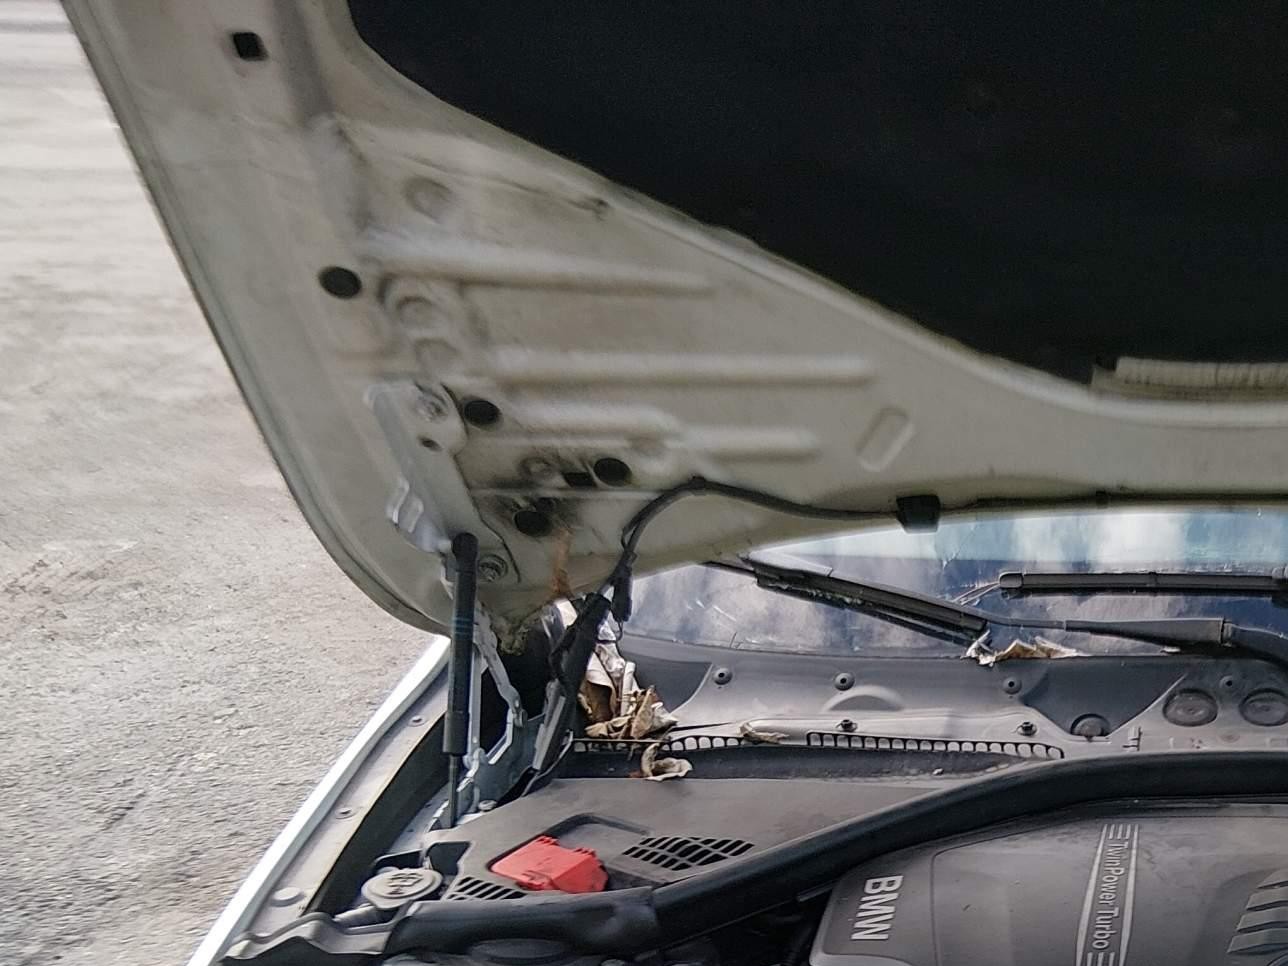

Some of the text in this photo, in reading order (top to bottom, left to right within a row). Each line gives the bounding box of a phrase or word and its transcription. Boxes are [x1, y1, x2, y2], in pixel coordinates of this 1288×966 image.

[851, 875, 904, 940] BMW
[1092, 842, 1128, 949] TwinPower Turbo
